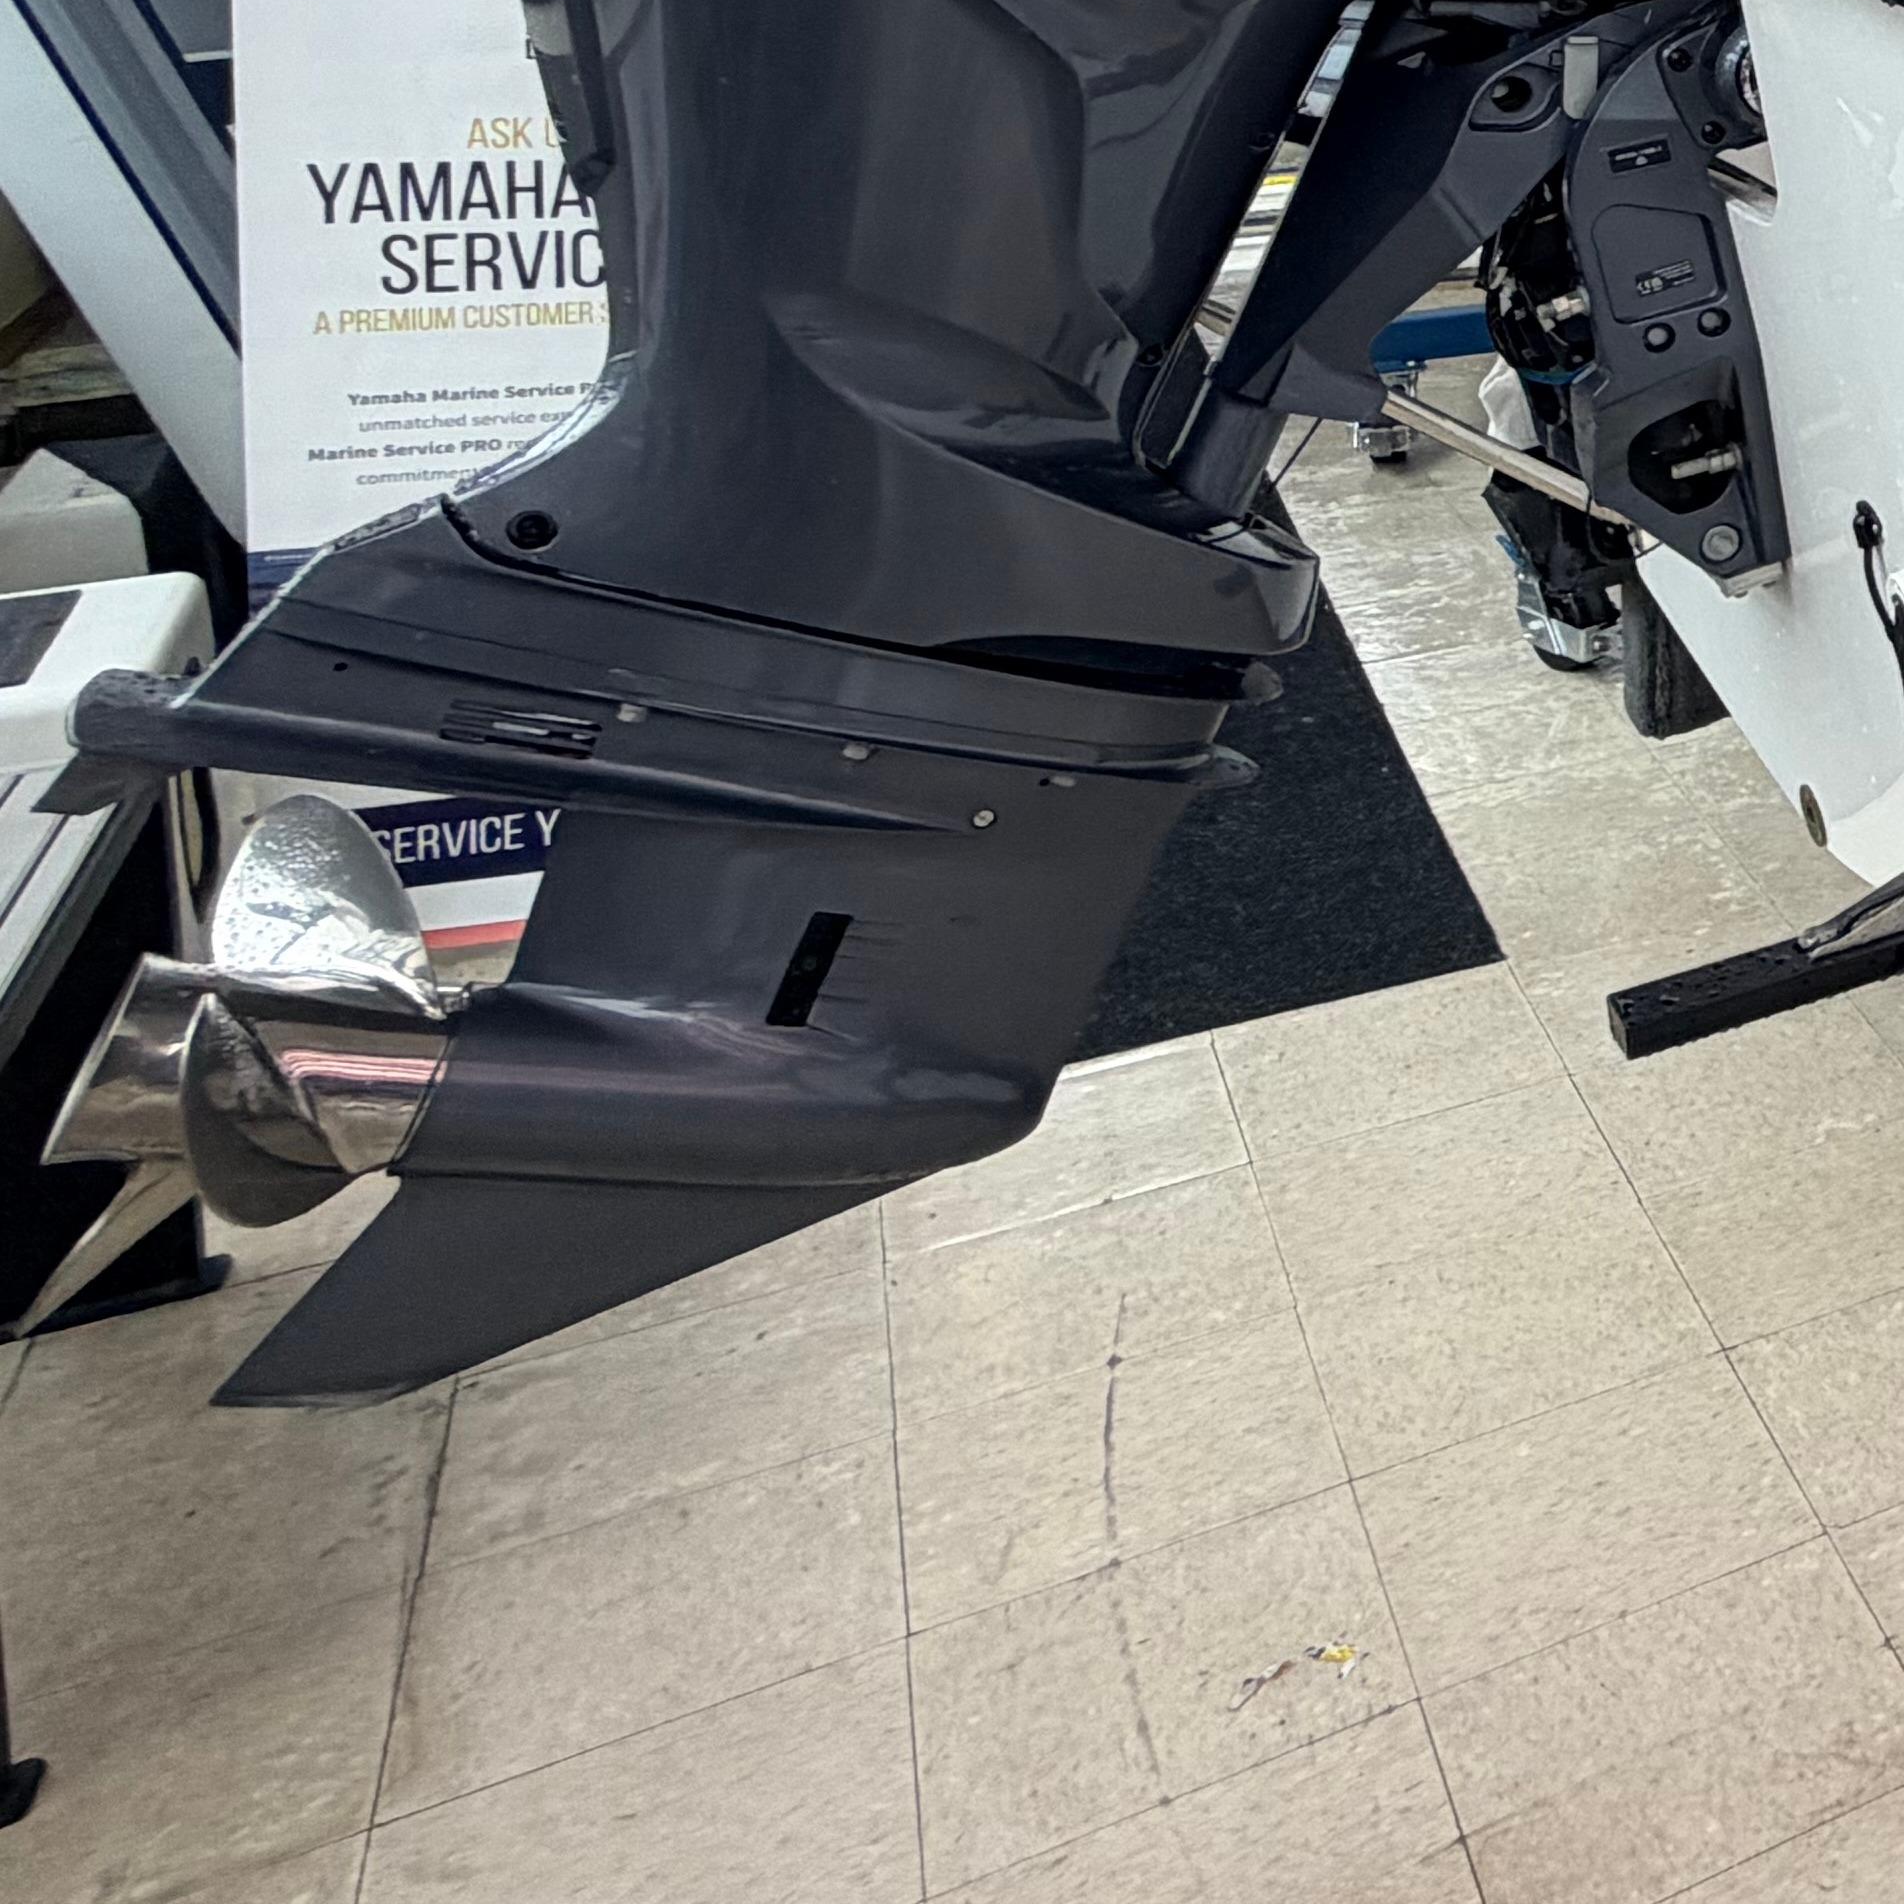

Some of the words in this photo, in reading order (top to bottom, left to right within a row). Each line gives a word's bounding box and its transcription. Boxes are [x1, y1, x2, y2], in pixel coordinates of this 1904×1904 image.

[466, 116, 533, 149] ASK
[306, 159, 592, 224] YAMAHA
[312, 311, 332, 336] A
[339, 305, 456, 334] PREMIUM
[463, 300, 594, 330] CUSTOMER
[348, 390, 427, 406] Yamaha
[432, 387, 499, 402] Marine
[504, 382, 575, 399] Service
[359, 413, 467, 432] unmatched
[471, 410, 537, 426] service
[308, 446, 378, 461] Marine
[383, 441, 456, 457] Service
[460, 439, 502, 453] PRO
